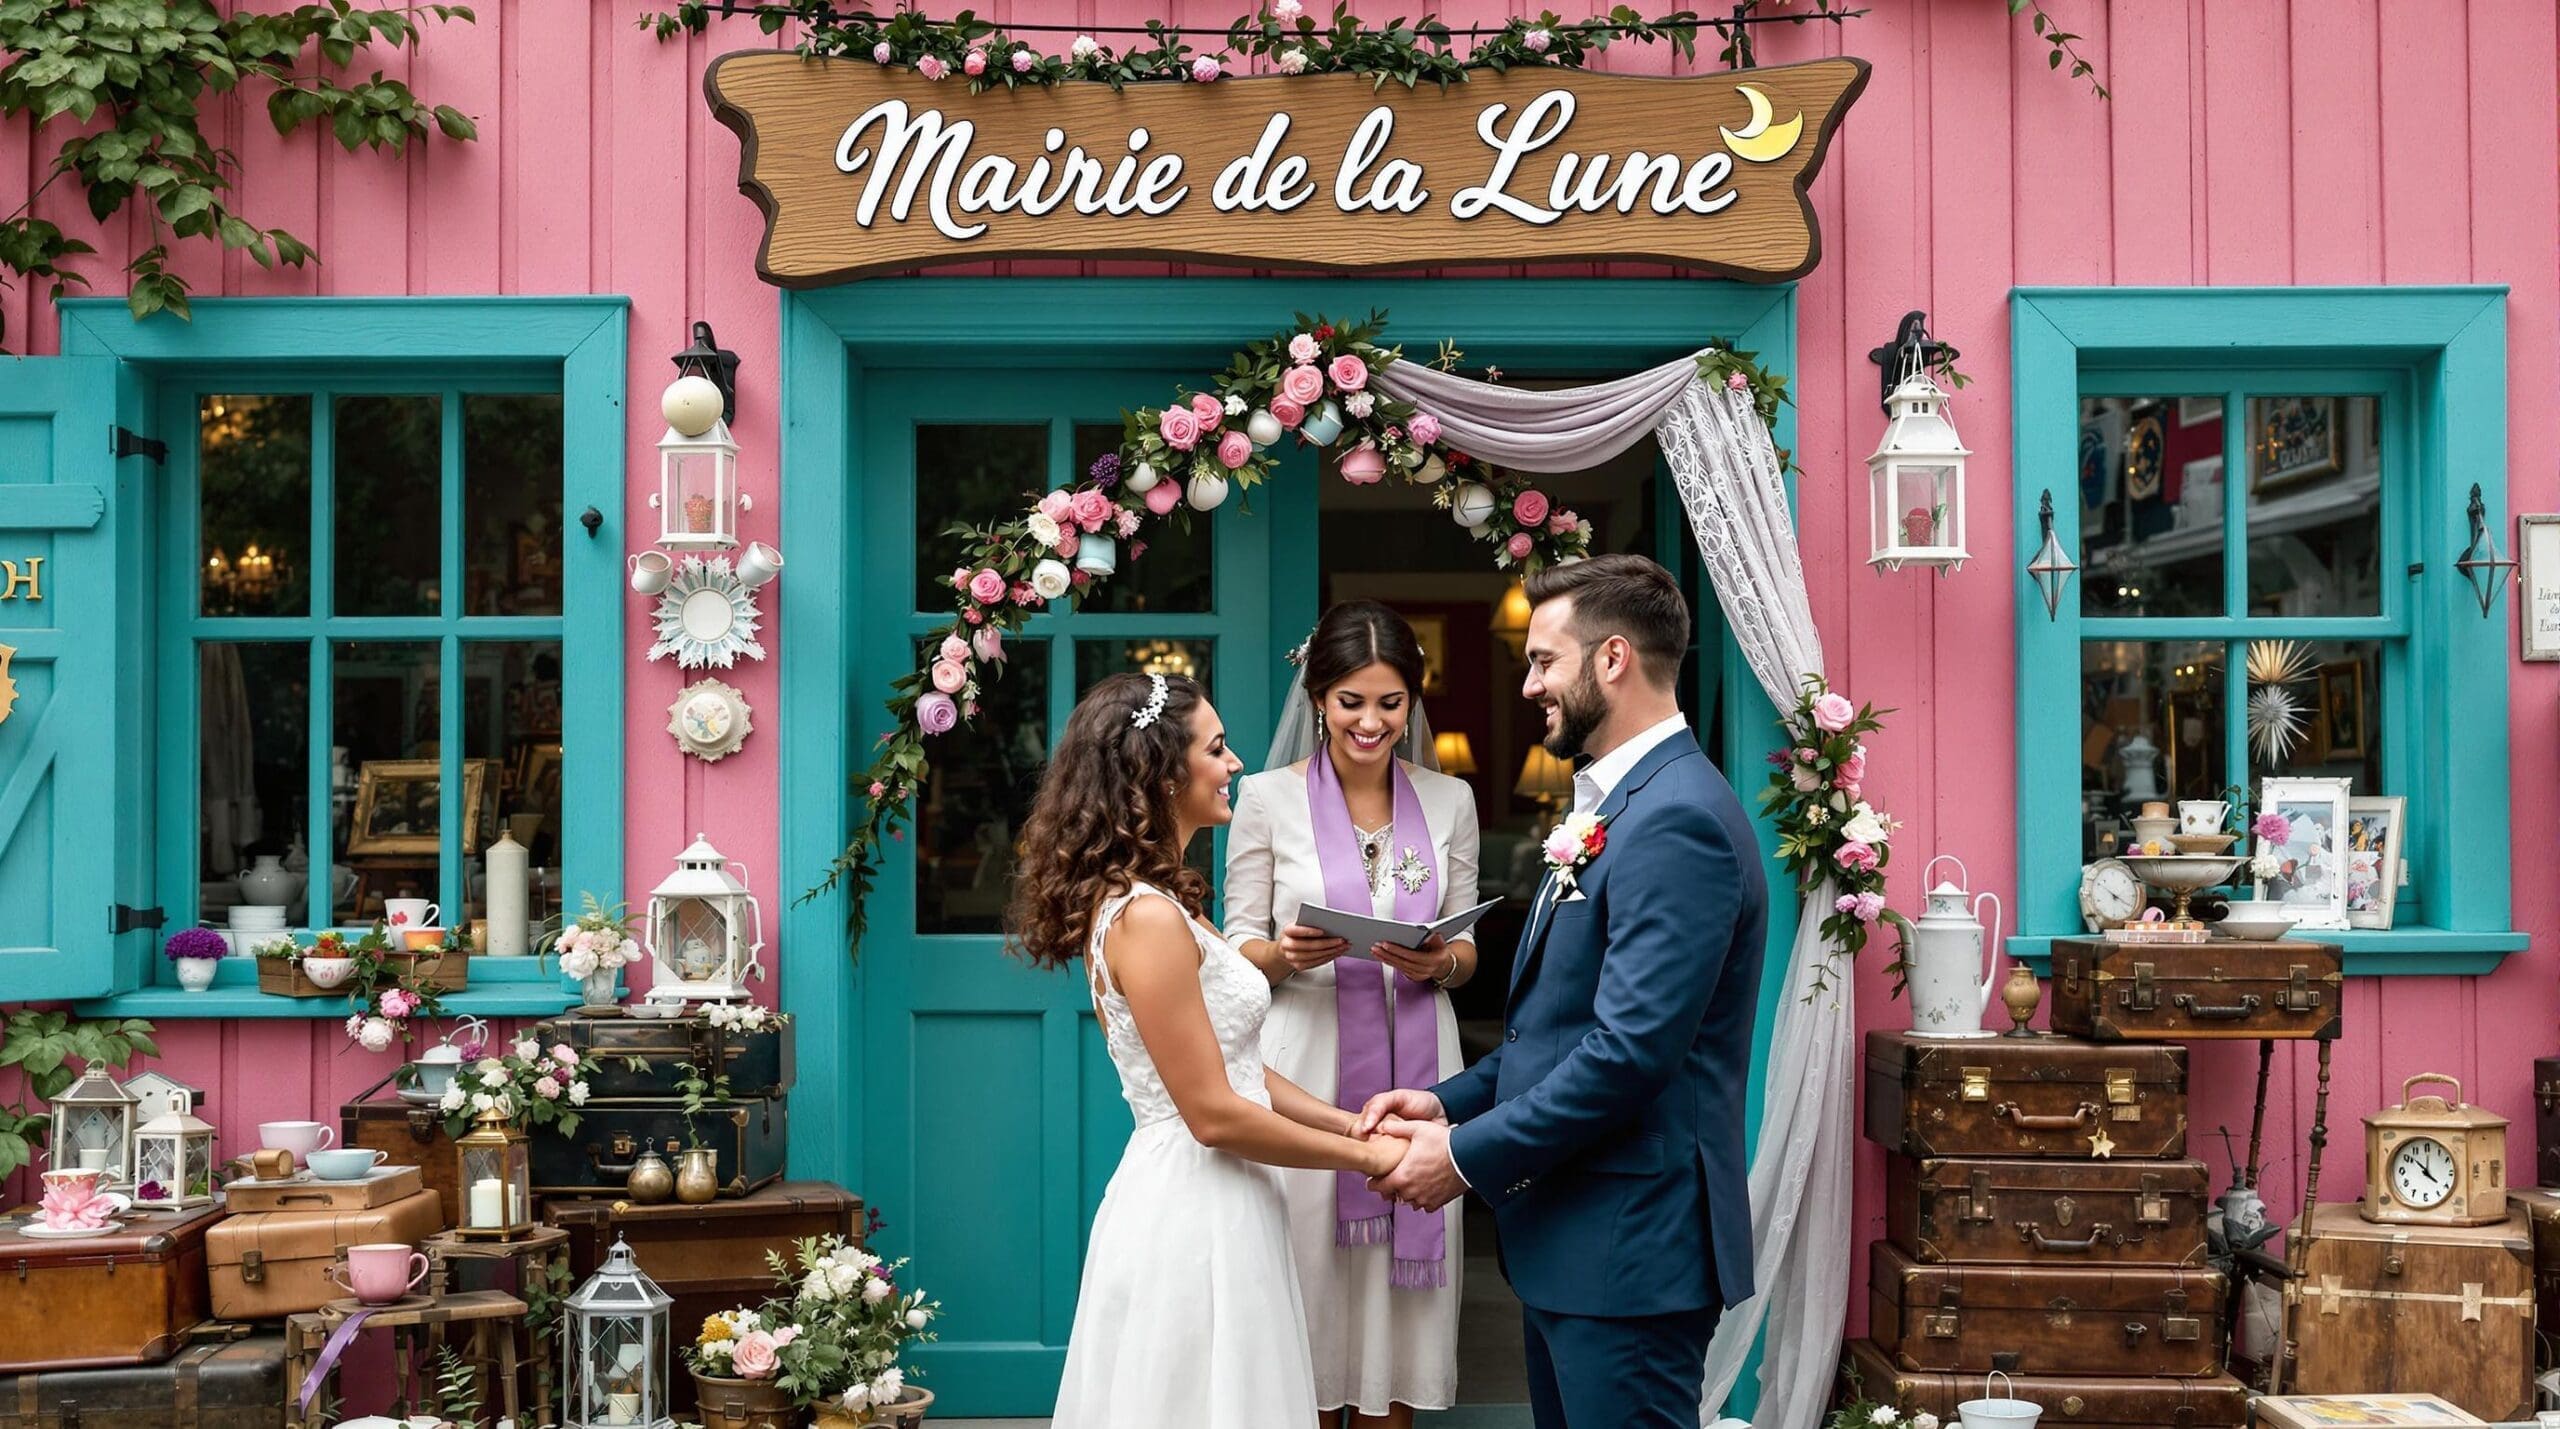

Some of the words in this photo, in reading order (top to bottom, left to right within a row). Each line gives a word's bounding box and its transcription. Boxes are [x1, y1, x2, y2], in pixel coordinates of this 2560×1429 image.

[834, 99, 1189, 240] Mairie
[1211, 112, 1316, 213] de
[1334, 105, 1429, 213] la
[1449, 89, 1738, 225] Lune
